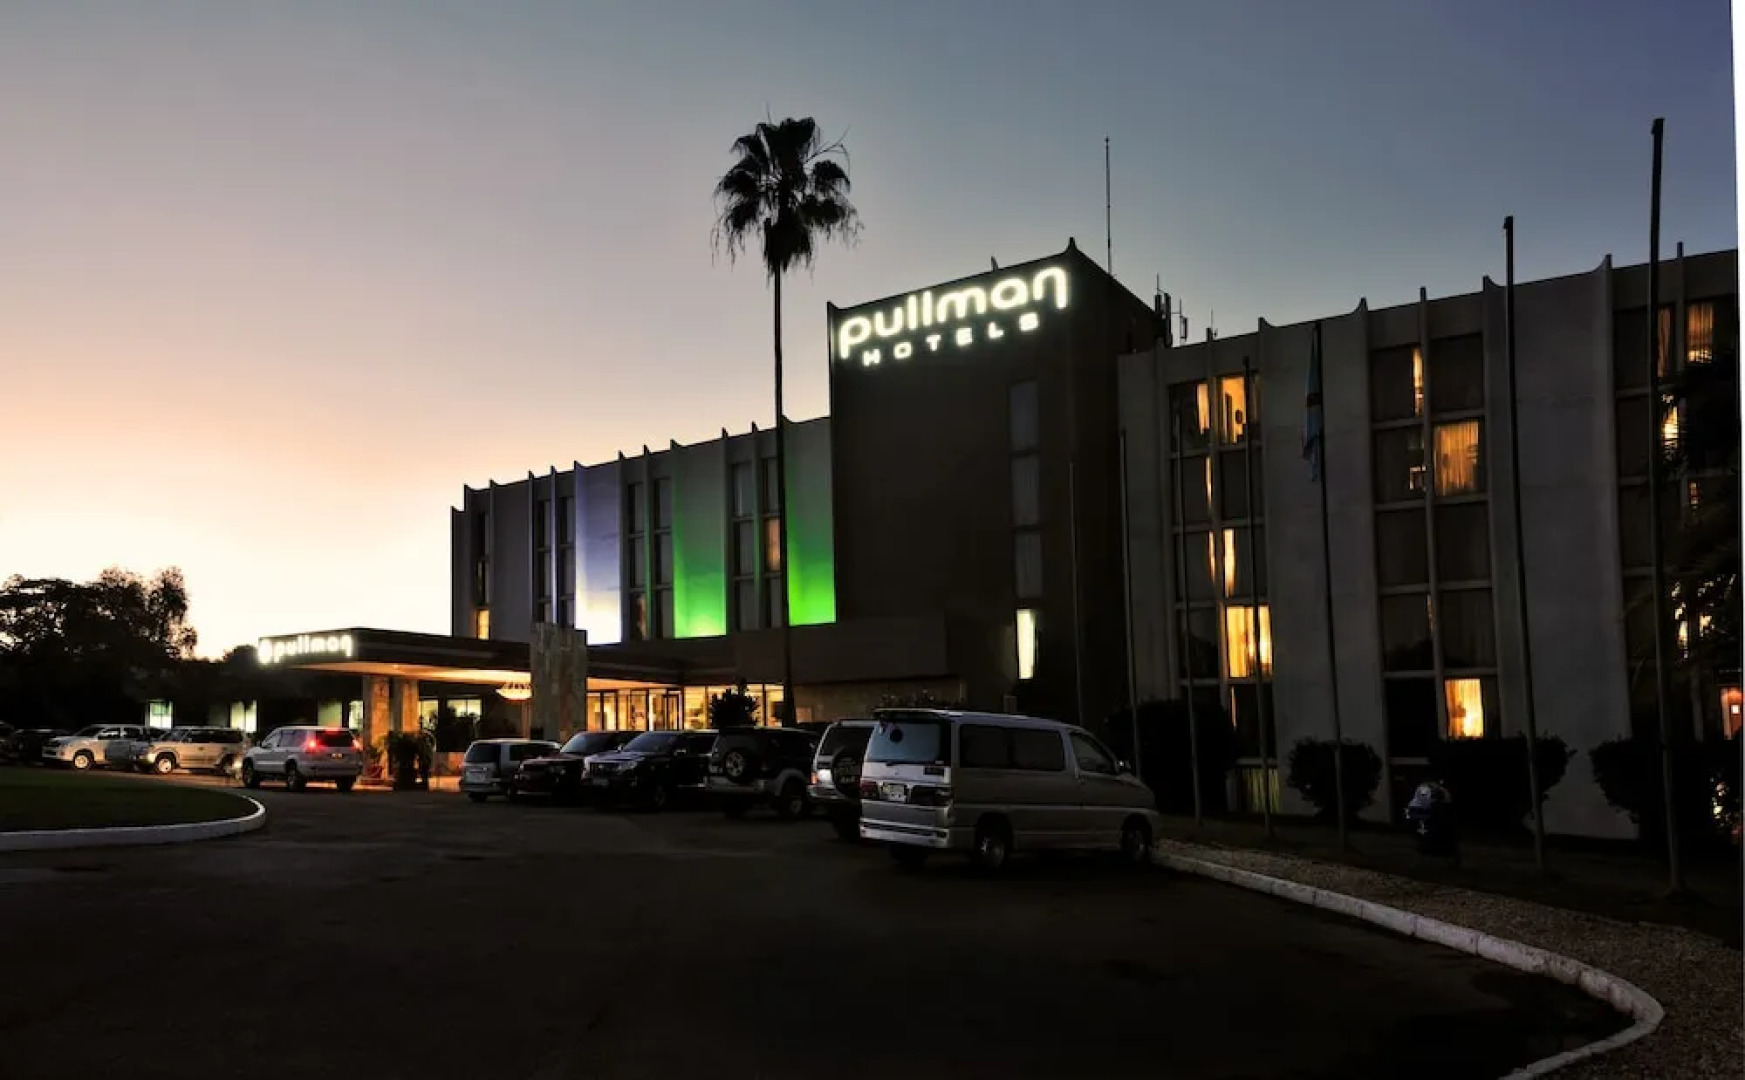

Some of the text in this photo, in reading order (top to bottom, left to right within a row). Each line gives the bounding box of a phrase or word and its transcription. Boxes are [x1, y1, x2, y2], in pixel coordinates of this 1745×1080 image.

[838, 266, 1069, 360] pullman
[862, 311, 1040, 367] HOTELS
[273, 634, 353, 664] pullman
